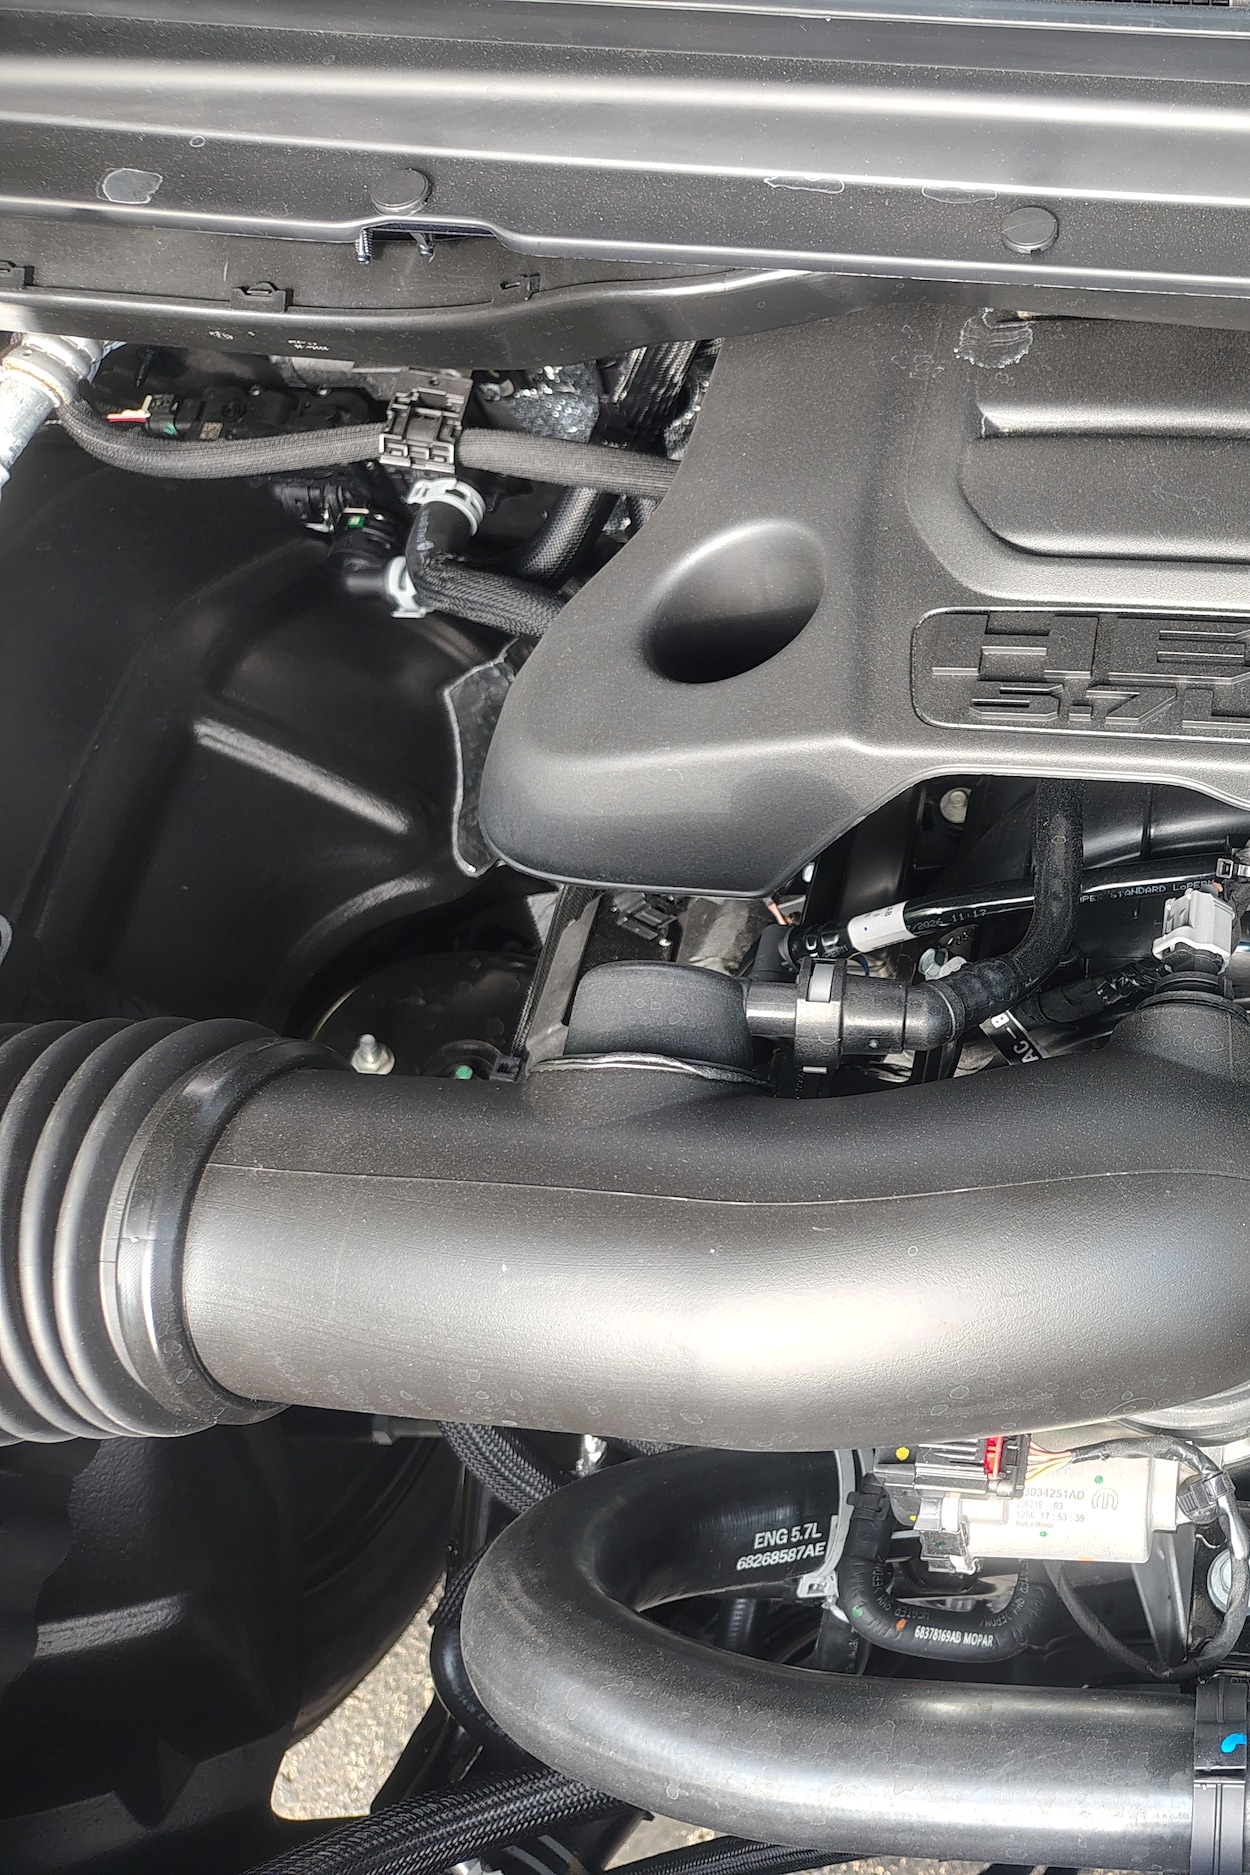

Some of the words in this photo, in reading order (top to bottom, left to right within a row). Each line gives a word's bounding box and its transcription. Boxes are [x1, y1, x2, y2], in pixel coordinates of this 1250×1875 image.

[1109, 884, 1167, 899] STANDARD
[1024, 1487, 1085, 1500] 3034251AD
[1053, 1501, 1064, 1510] R3
[753, 1528, 789, 1549] ENG
[790, 1522, 822, 1543] 5.7L
[736, 1541, 827, 1571] 68268587AE
[1018, 1557, 1030, 1594] EATER
[913, 1624, 962, 1645] 68378169AB
[962, 1632, 995, 1648] MOPAR
